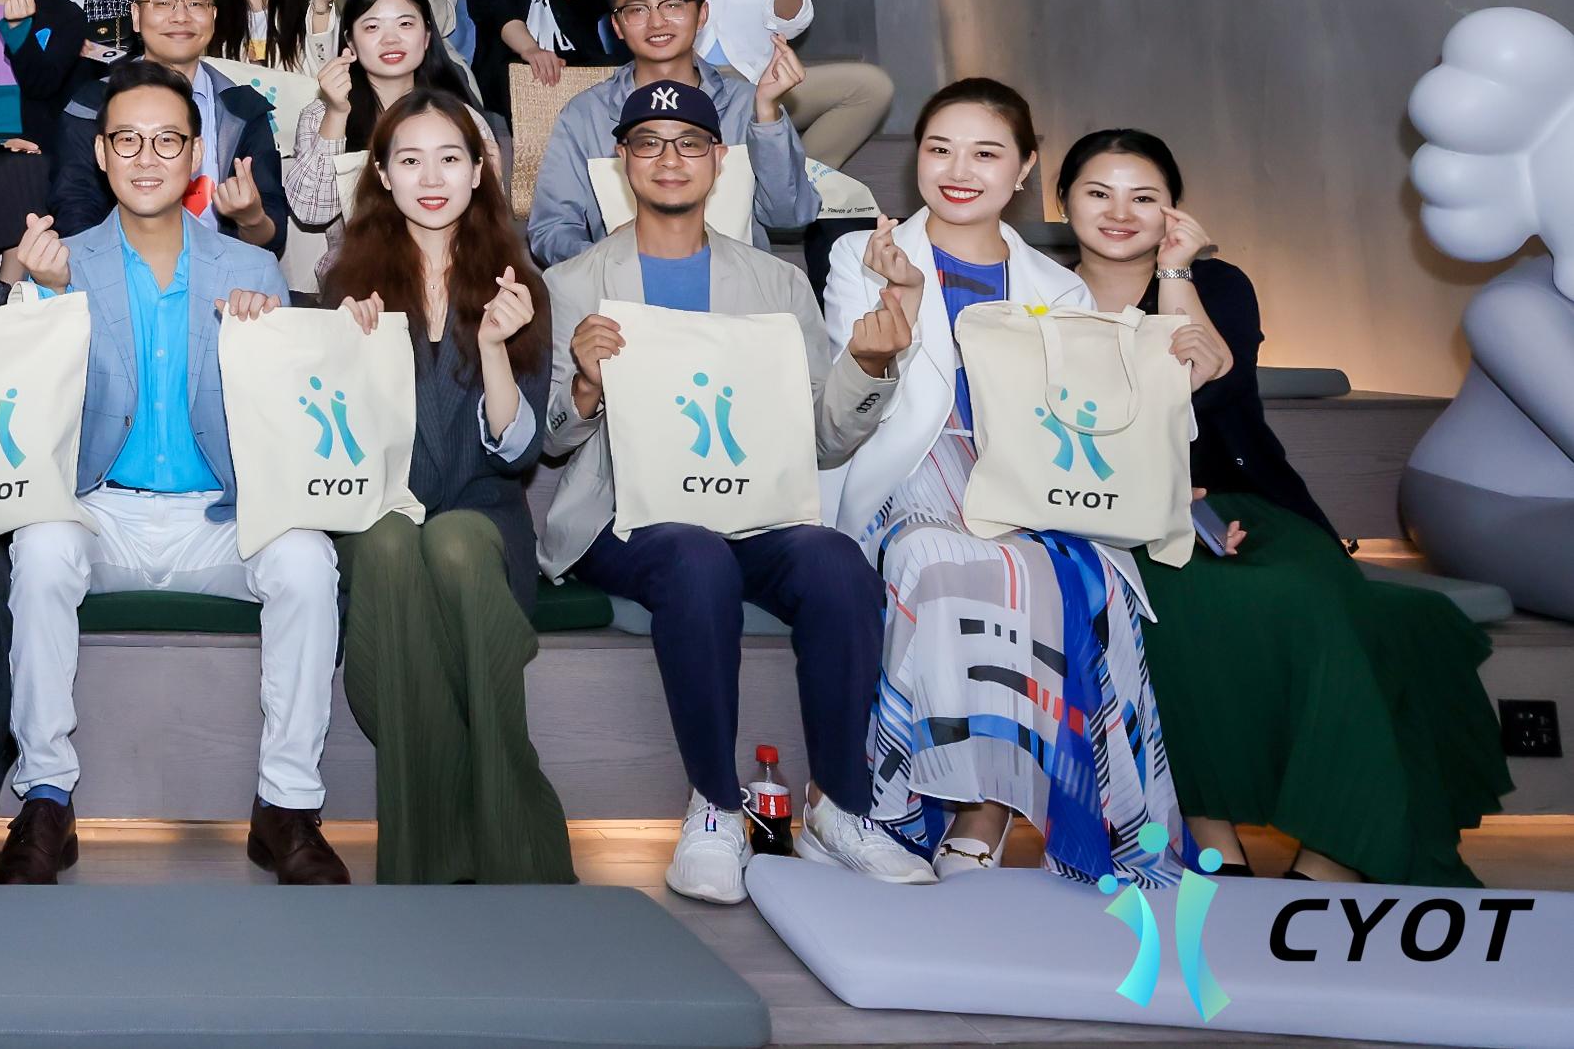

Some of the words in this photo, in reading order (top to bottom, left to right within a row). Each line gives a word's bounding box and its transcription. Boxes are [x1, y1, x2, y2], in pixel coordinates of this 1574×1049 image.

[650, 86, 679, 110] NY
[307, 477, 369, 497] CYOT
[682, 475, 750, 495] CYOT
[1047, 487, 1120, 510] CYOT
